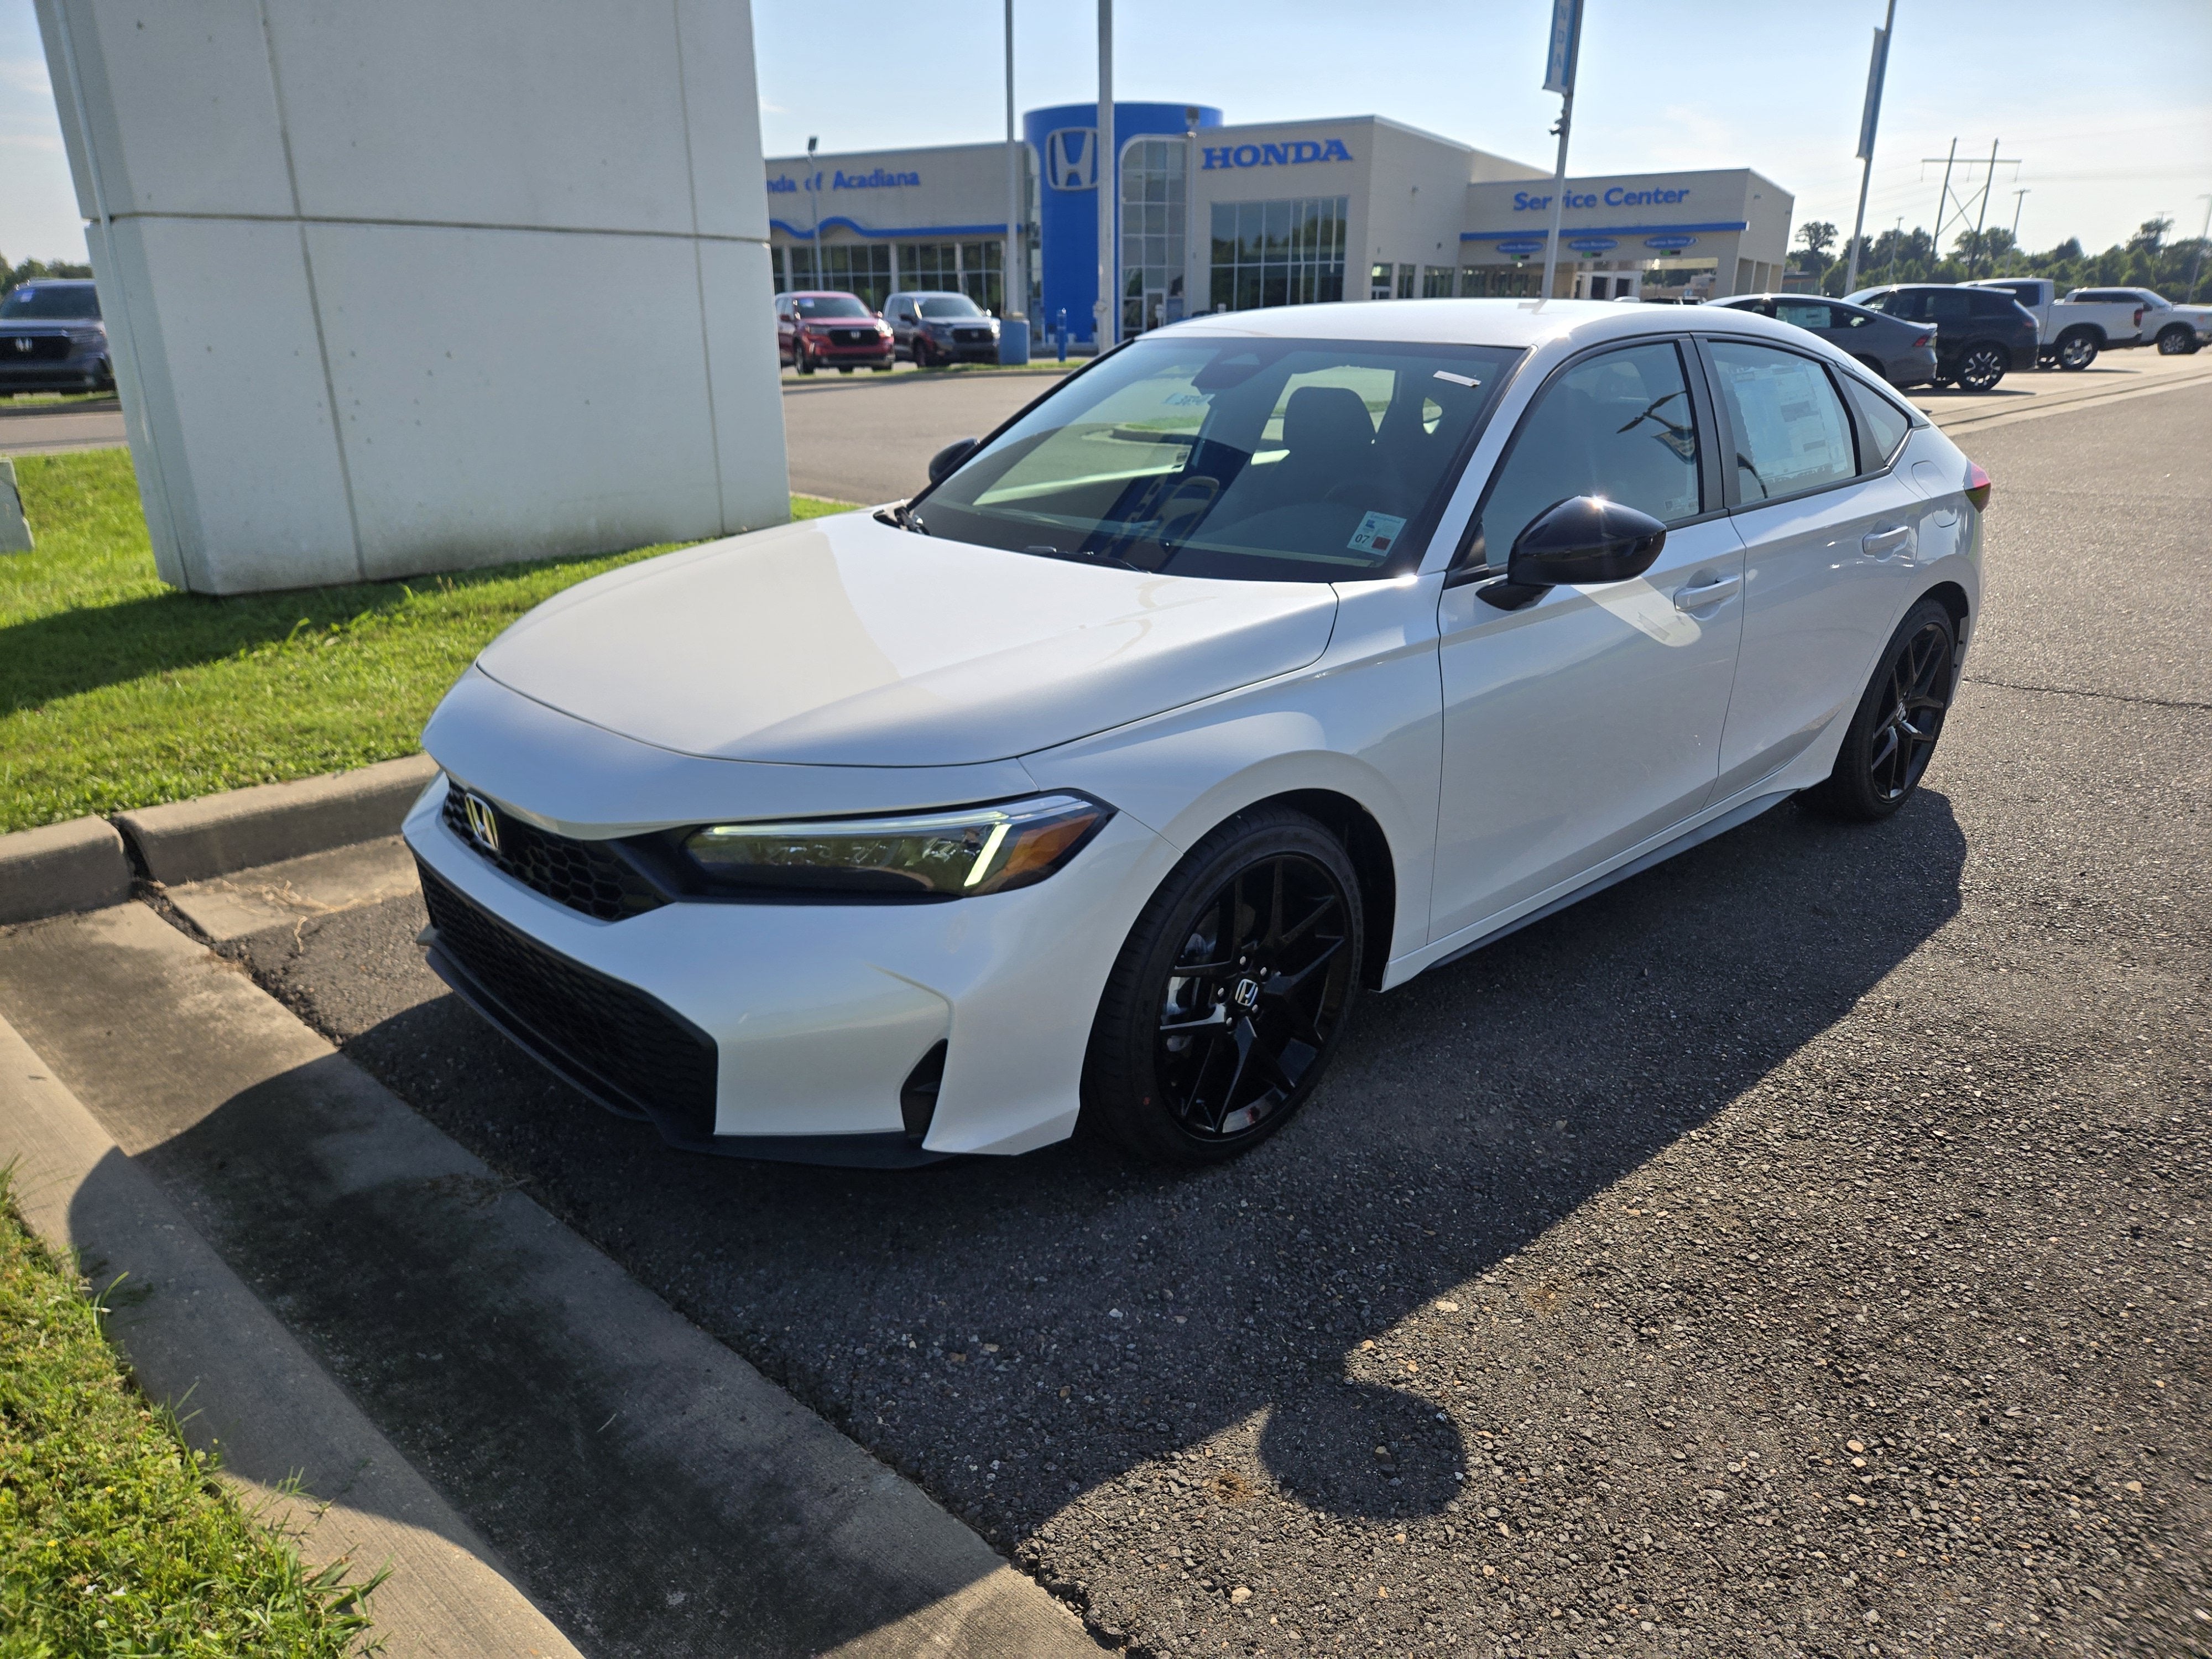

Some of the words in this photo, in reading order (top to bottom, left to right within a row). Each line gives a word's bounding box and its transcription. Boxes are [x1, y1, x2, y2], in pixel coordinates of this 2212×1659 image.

[1202, 139, 1353, 170] HONDA
[766, 174, 796, 191] nda
[833, 168, 920, 191] Acadiana
[1513, 189, 1597, 211] Serice
[1604, 187, 1689, 206] Center
[1355, 534, 1370, 544] 07
